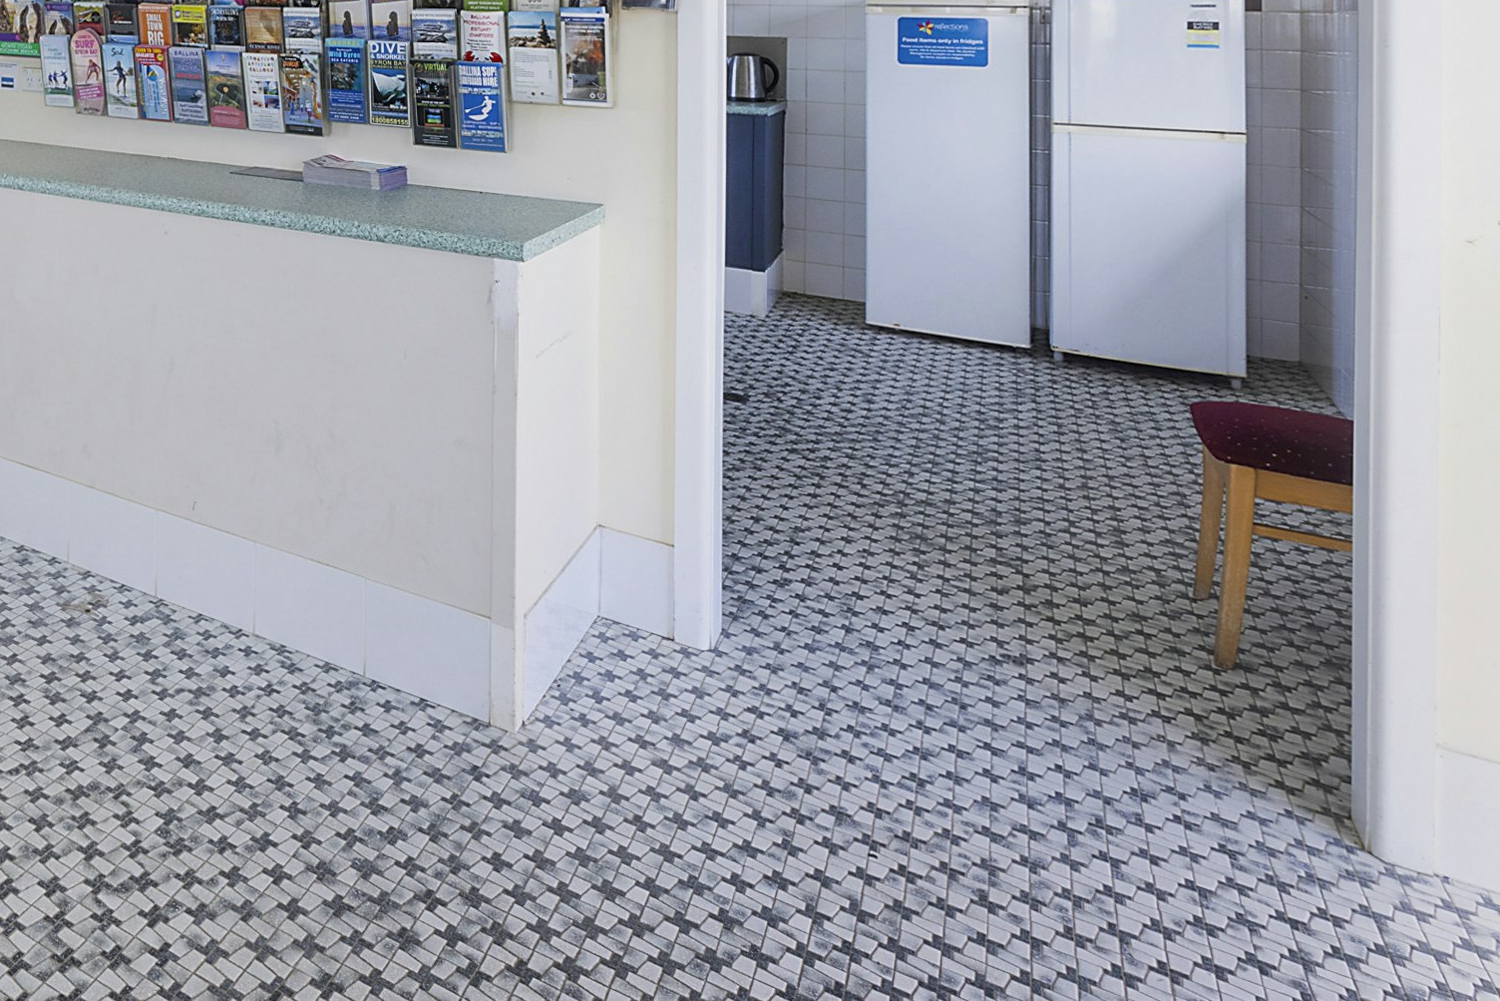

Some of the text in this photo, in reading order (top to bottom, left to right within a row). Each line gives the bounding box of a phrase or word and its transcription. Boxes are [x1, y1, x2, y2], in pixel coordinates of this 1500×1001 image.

[147, 22, 162, 31] TOWN
[148, 32, 164, 46] BIG
[75, 40, 95, 48] SURF
[370, 42, 406, 53] DIVE
[459, 66, 481, 76] BALLINA
[482, 77, 498, 86] HIRE
